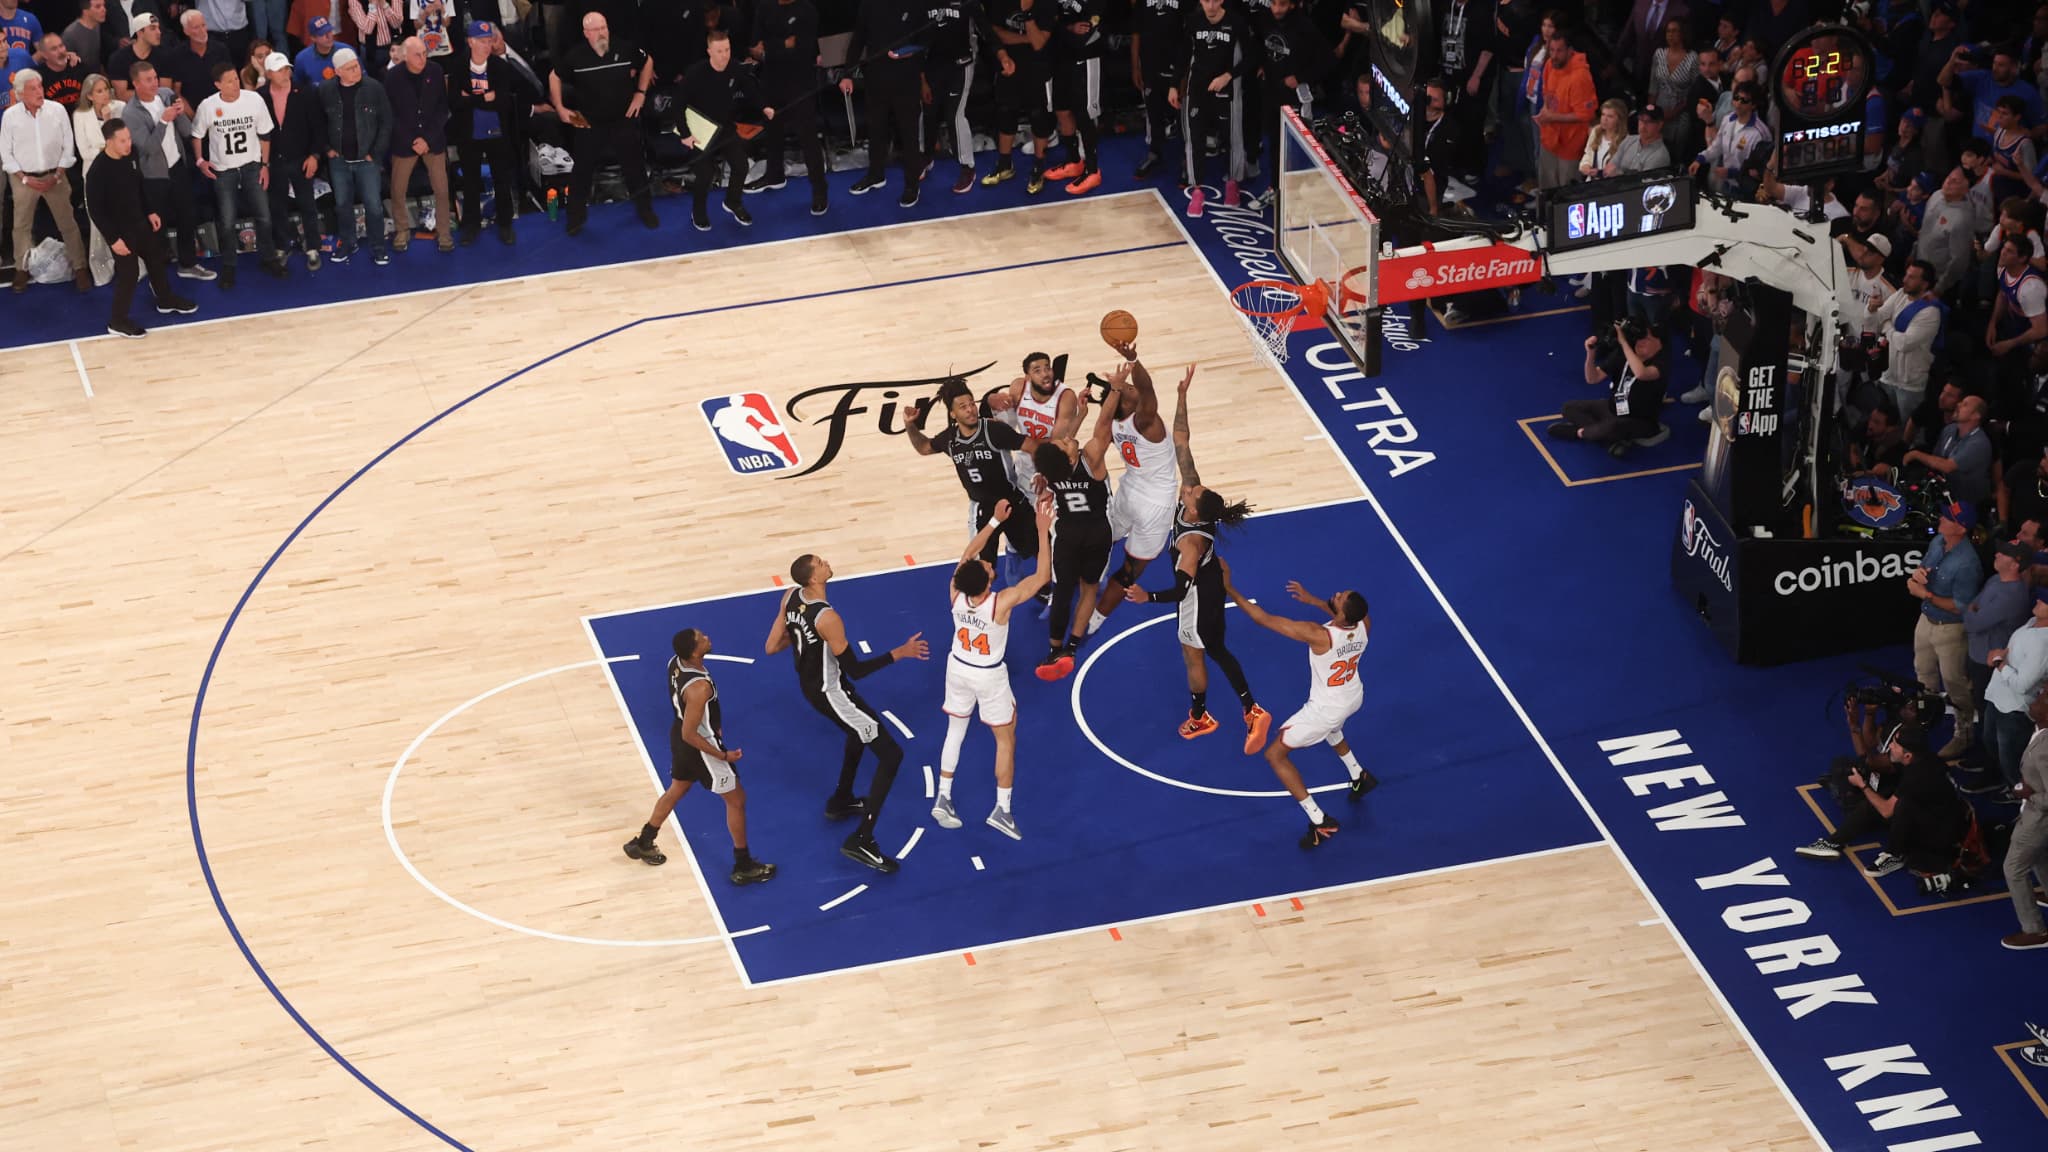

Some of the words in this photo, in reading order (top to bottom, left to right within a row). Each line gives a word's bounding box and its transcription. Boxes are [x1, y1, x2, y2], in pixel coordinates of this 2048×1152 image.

[224, 131, 248, 155] 12
[1806, 121, 1861, 140] TISSOT
[1586, 201, 1624, 239] App
[1748, 365, 1776, 388] GET
[1304, 340, 1437, 478] ULTRA
[1747, 387, 1774, 410] THE
[1023, 420, 1048, 440] 32
[1750, 411, 1778, 437] App
[737, 453, 775, 470] NBA
[967, 468, 983, 483] 5
[1064, 492, 1091, 512] 2
[1686, 517, 1733, 592] Finals
[1774, 550, 1926, 596] coinbas
[957, 626, 990, 655] 44
[1327, 654, 1361, 687] 25
[1597, 729, 1747, 831] NEW
[1695, 857, 1879, 1020] YORK
[1823, 1044, 1984, 1152] KNI
